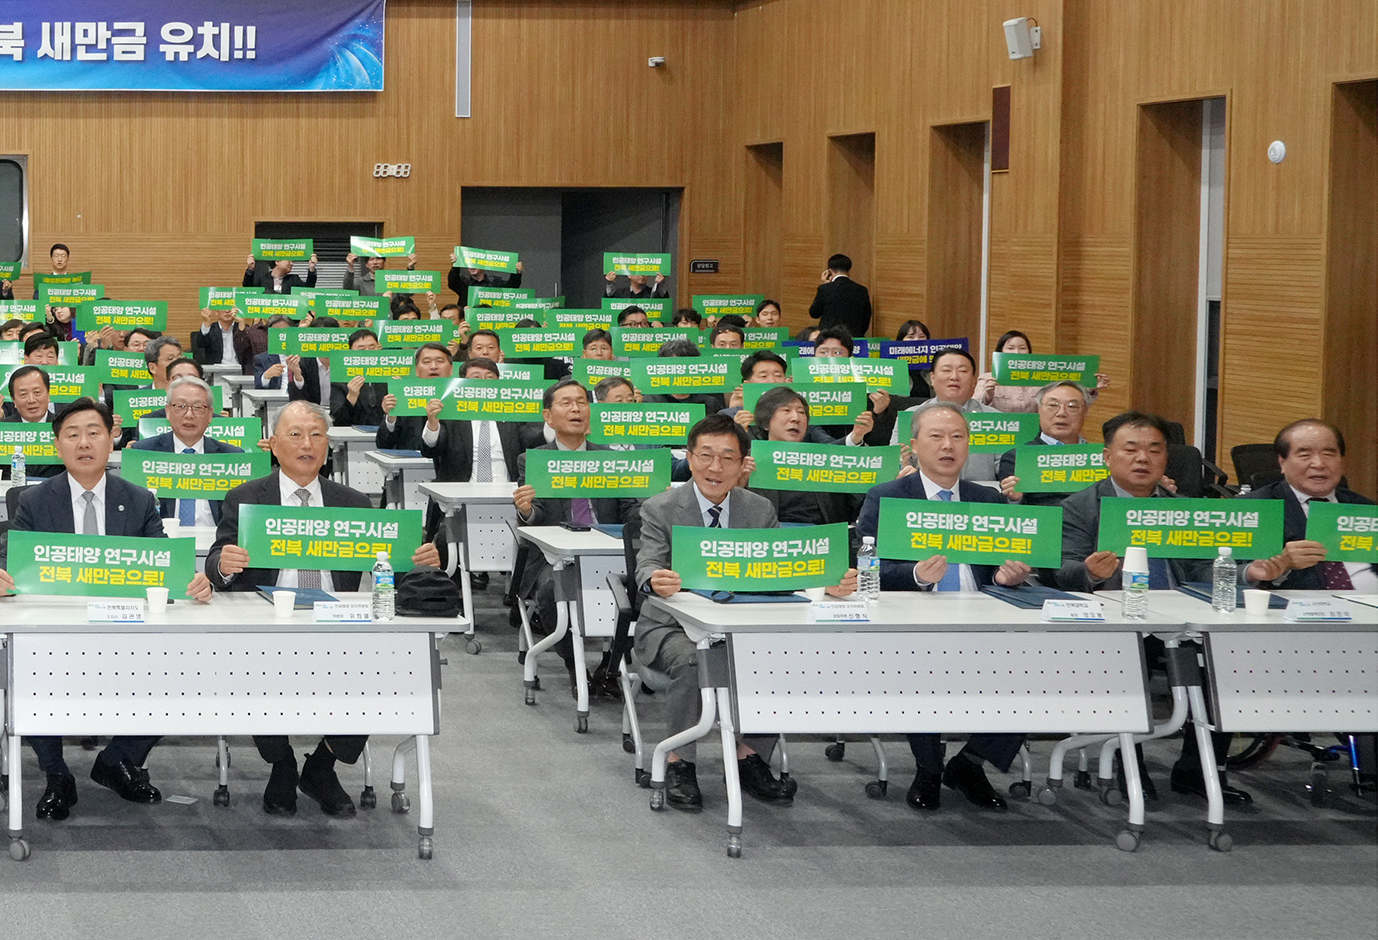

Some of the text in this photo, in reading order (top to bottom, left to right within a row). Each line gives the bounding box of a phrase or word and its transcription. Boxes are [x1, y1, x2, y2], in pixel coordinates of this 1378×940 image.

[38, 22, 146, 60] 새만금
[160, 22, 256, 61] 유치!!
[92, 305, 157, 316] 인공태양 연구시설
[96, 315, 112, 325] 전북
[385, 324, 443, 334] 인공태양 연구시설
[511, 332, 576, 343] 인공태양 연구시설
[532, 342, 574, 352] 새만금으로!
[343, 356, 413, 366] 인공태양 연구시설
[1007, 359, 1086, 371] 인공태양 연구시설
[347, 366, 411, 377] 전북 새만금으로!
[646, 363, 728, 375] 인공태양 연구시설
[650, 375, 726, 387] 전북 새만금으로!
[1010, 370, 1082, 382] 전북 새만금으로!
[453, 387, 544, 400] 인공태양 연구시설
[456, 400, 541, 414] 전북 새만금으로!
[599, 411, 690, 424] 인공태양 연구시설
[604, 424, 687, 437] 전북 새만금으로!
[773, 451, 882, 468] 인공태양 연구시설
[142, 461, 251, 476] 인공태양 연구시설
[548, 460, 653, 473] 인공태양 연구시설
[778, 467, 877, 483] 전북 새만금으로!
[147, 477, 173, 489] 전북
[552, 476, 649, 488] 전북 새만금으로!
[906, 512, 1037, 534] 인공태양 연구시설
[1126, 510, 1258, 527] 인공태양 연구시설
[266, 519, 398, 538] 인공태양 연구시설
[912, 533, 1032, 554] 전북 새만금으로!
[1131, 530, 1252, 547] 전북 새만금으로!
[271, 540, 392, 558] 전북 새만금으로!
[700, 538, 829, 557] 인공태양 연구시설
[34, 546, 170, 566] 인공태양 연구시설
[707, 560, 825, 578] 전북 새만금으로!
[40, 566, 164, 586] 전북 새만금으로!
